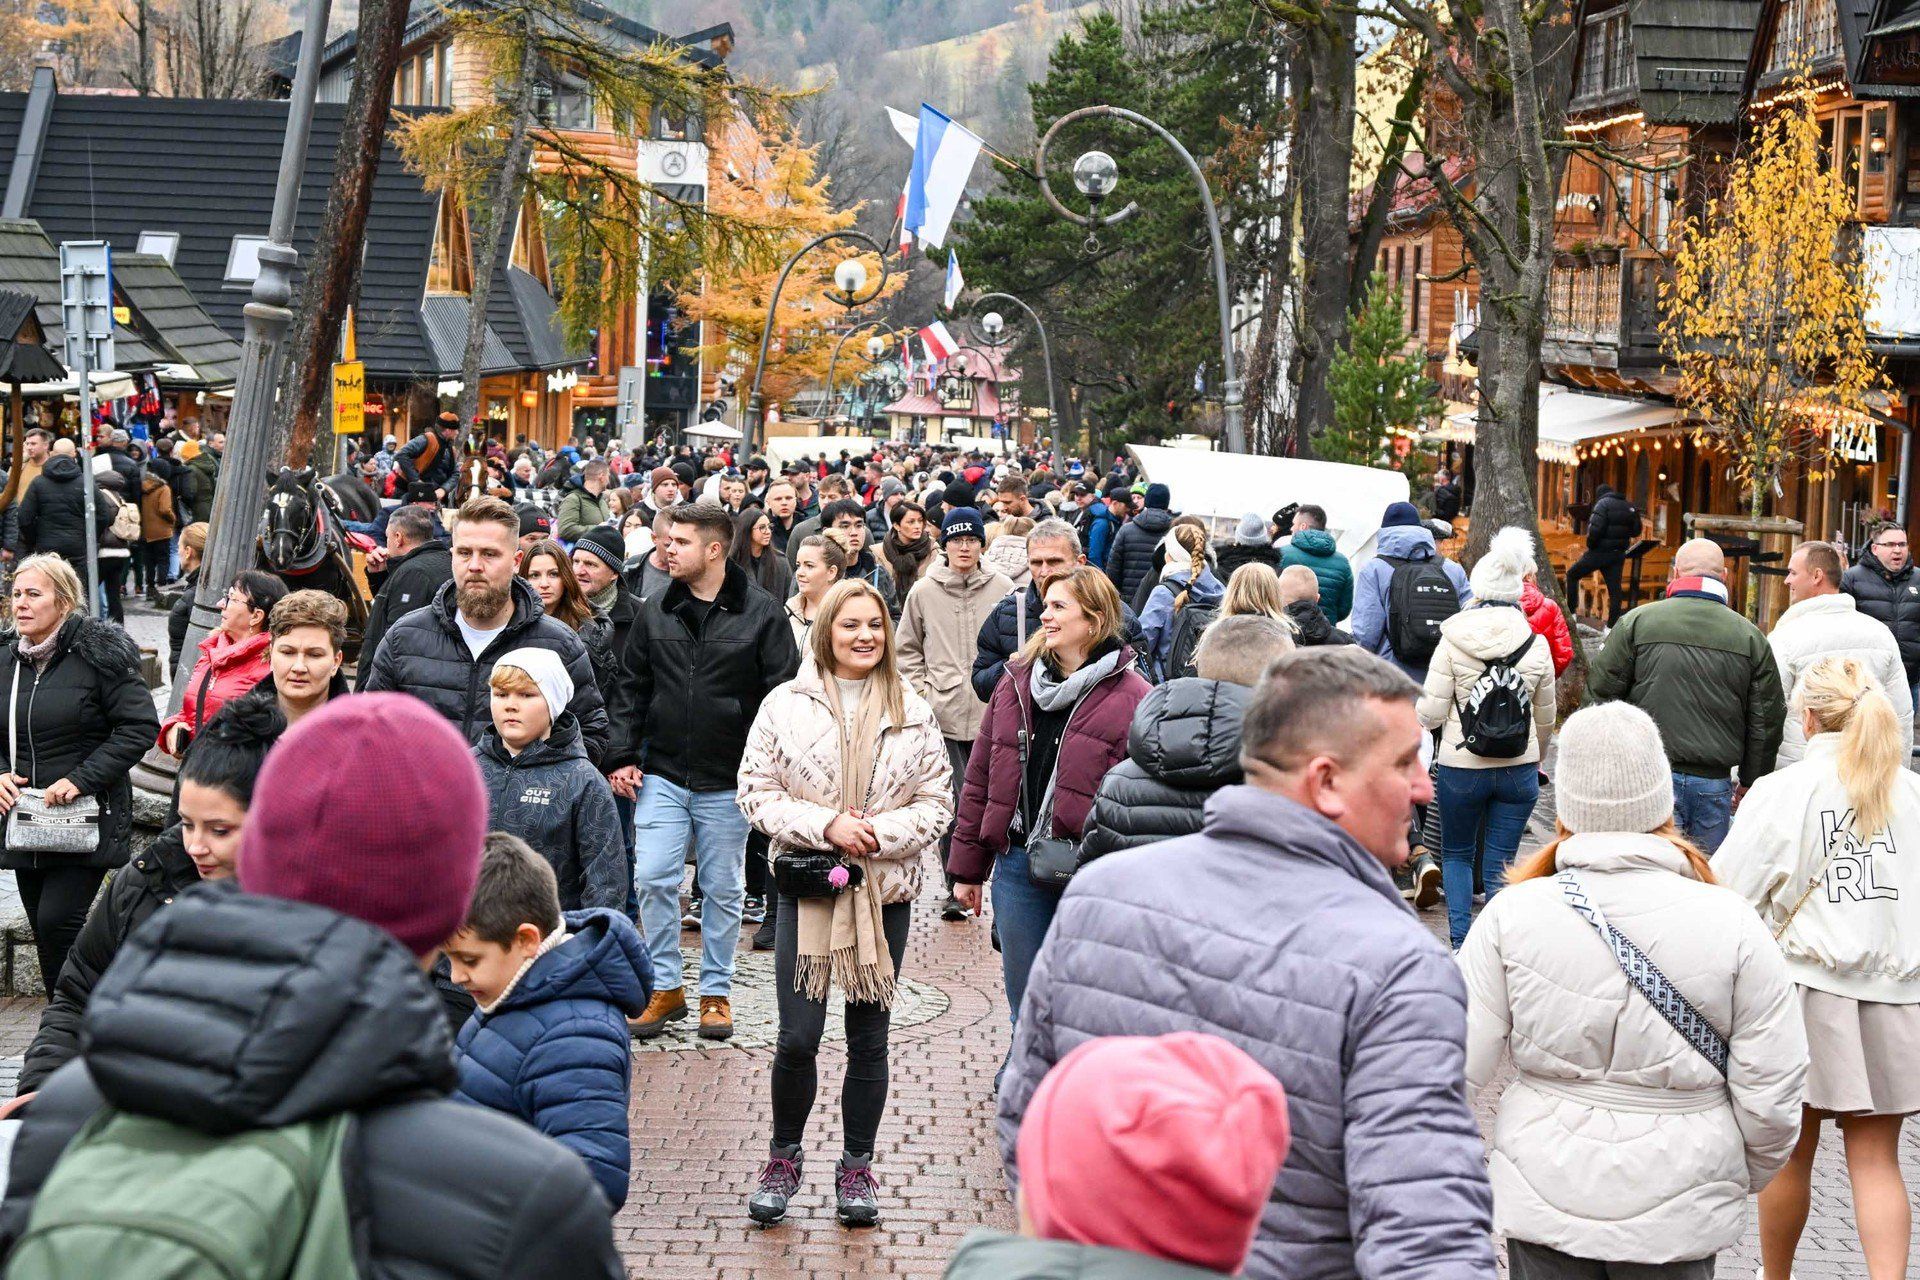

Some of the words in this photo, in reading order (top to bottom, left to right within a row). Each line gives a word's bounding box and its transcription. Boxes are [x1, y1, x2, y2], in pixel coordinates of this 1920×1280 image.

[1830, 418, 1878, 463] PIZZA
[525, 789, 552, 798] OUT
[520, 795, 550, 805] SIDE
[30, 815, 67, 824] CHRISTIAN
[69, 816, 86, 824] DIOR
